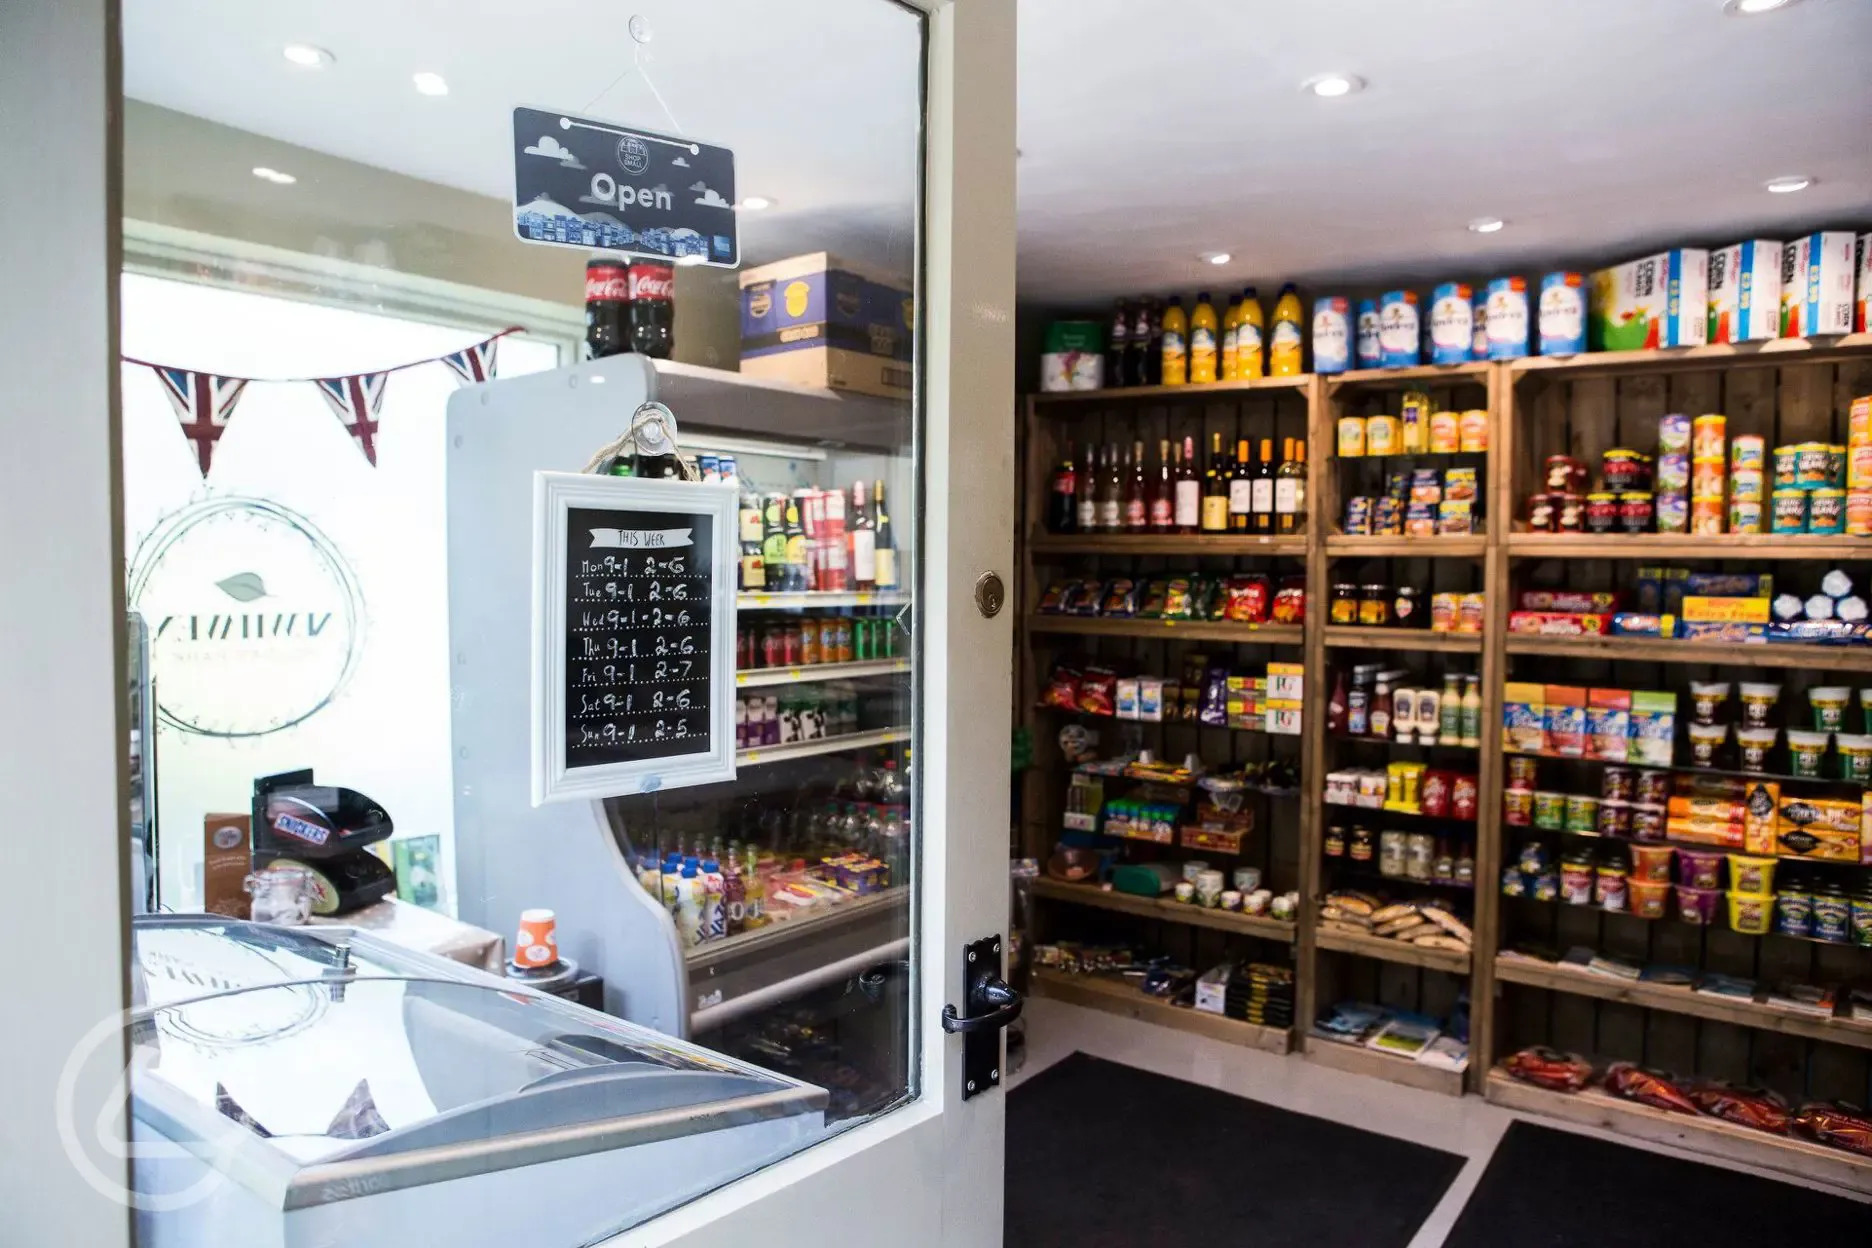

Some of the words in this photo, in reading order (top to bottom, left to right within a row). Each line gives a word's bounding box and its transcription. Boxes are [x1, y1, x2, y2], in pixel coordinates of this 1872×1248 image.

[590, 172, 672, 211] Open
[617, 530, 638, 547] THIS
[644, 531, 666, 546] WEEK
[582, 560, 603, 574] Mon
[583, 581, 602, 597] Tue
[582, 611, 605, 626] Wed
[582, 637, 601, 657] Thu
[582, 667, 597, 683] Fri
[581, 693, 601, 714] Sat
[580, 723, 600, 744] Sun
